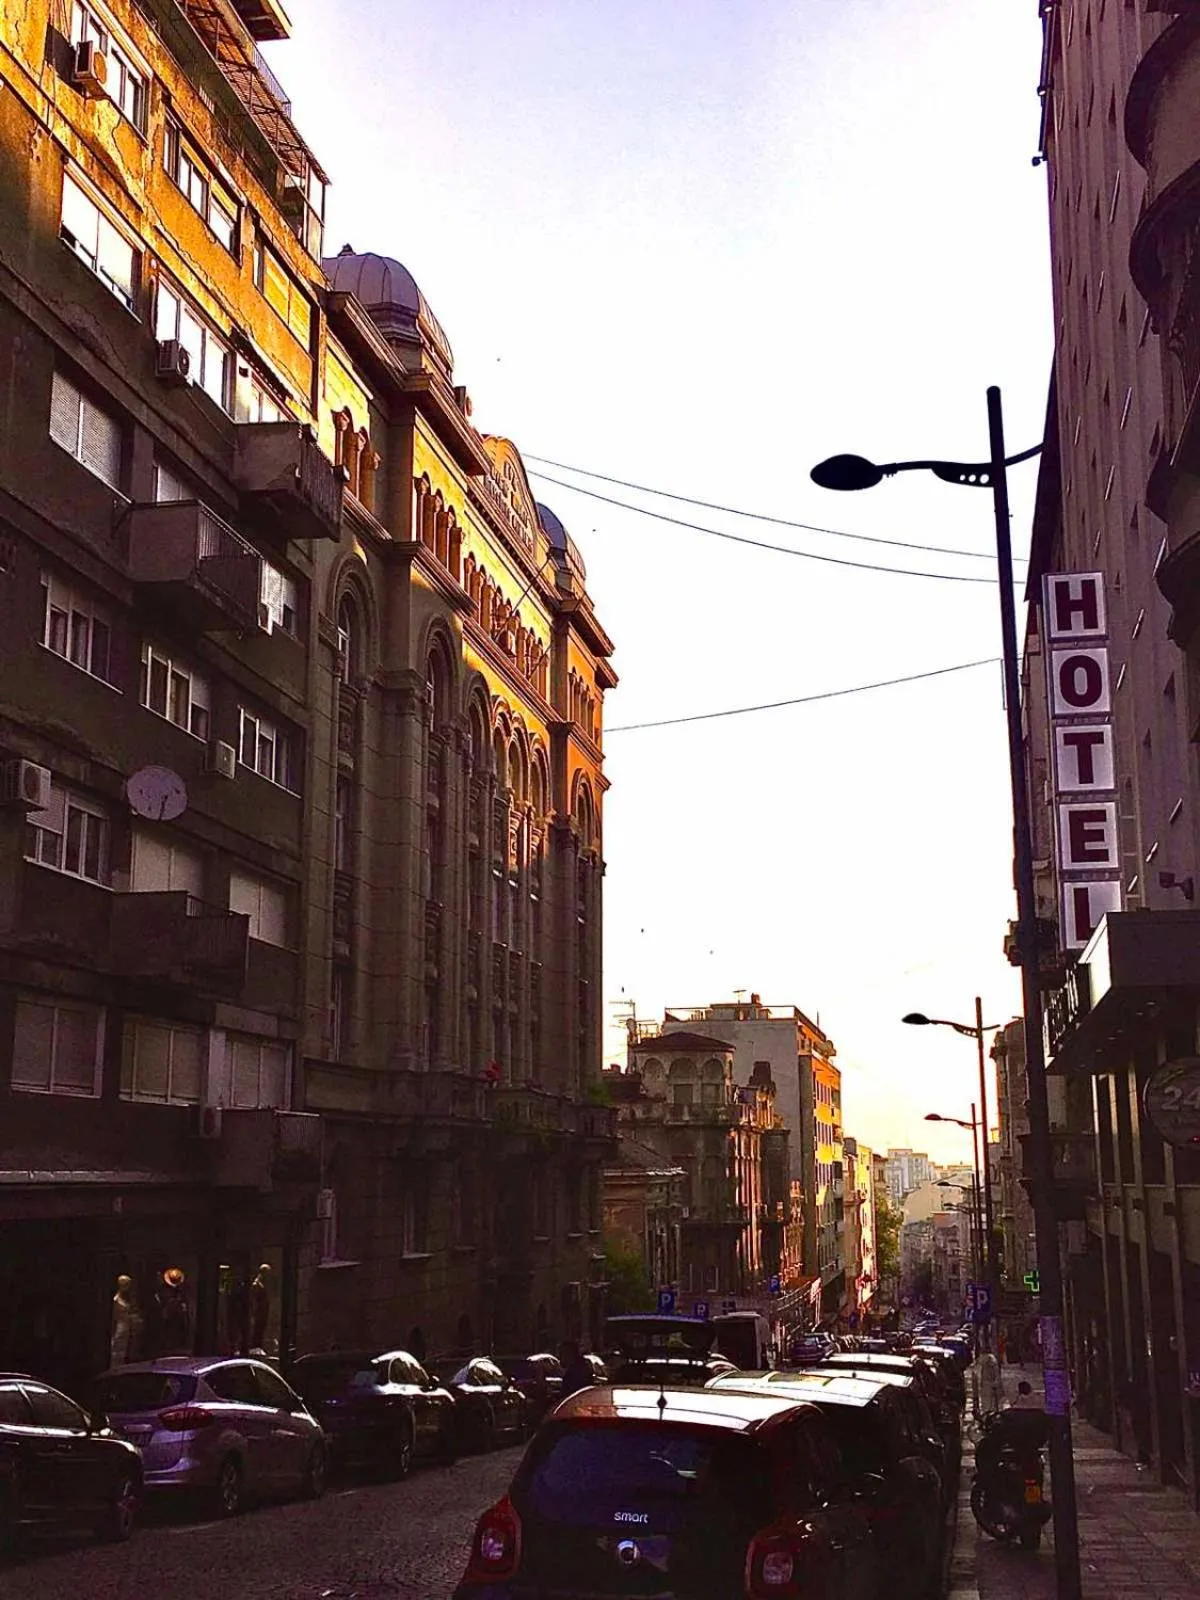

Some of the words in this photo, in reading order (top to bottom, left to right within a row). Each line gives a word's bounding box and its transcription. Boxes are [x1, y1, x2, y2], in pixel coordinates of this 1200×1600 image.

[1055, 579, 1110, 941] HOTEL
[661, 1293, 671, 1306] P
[977, 1290, 988, 1310] P
[697, 1304, 706, 1317] P
[614, 1511, 648, 1524] smart
